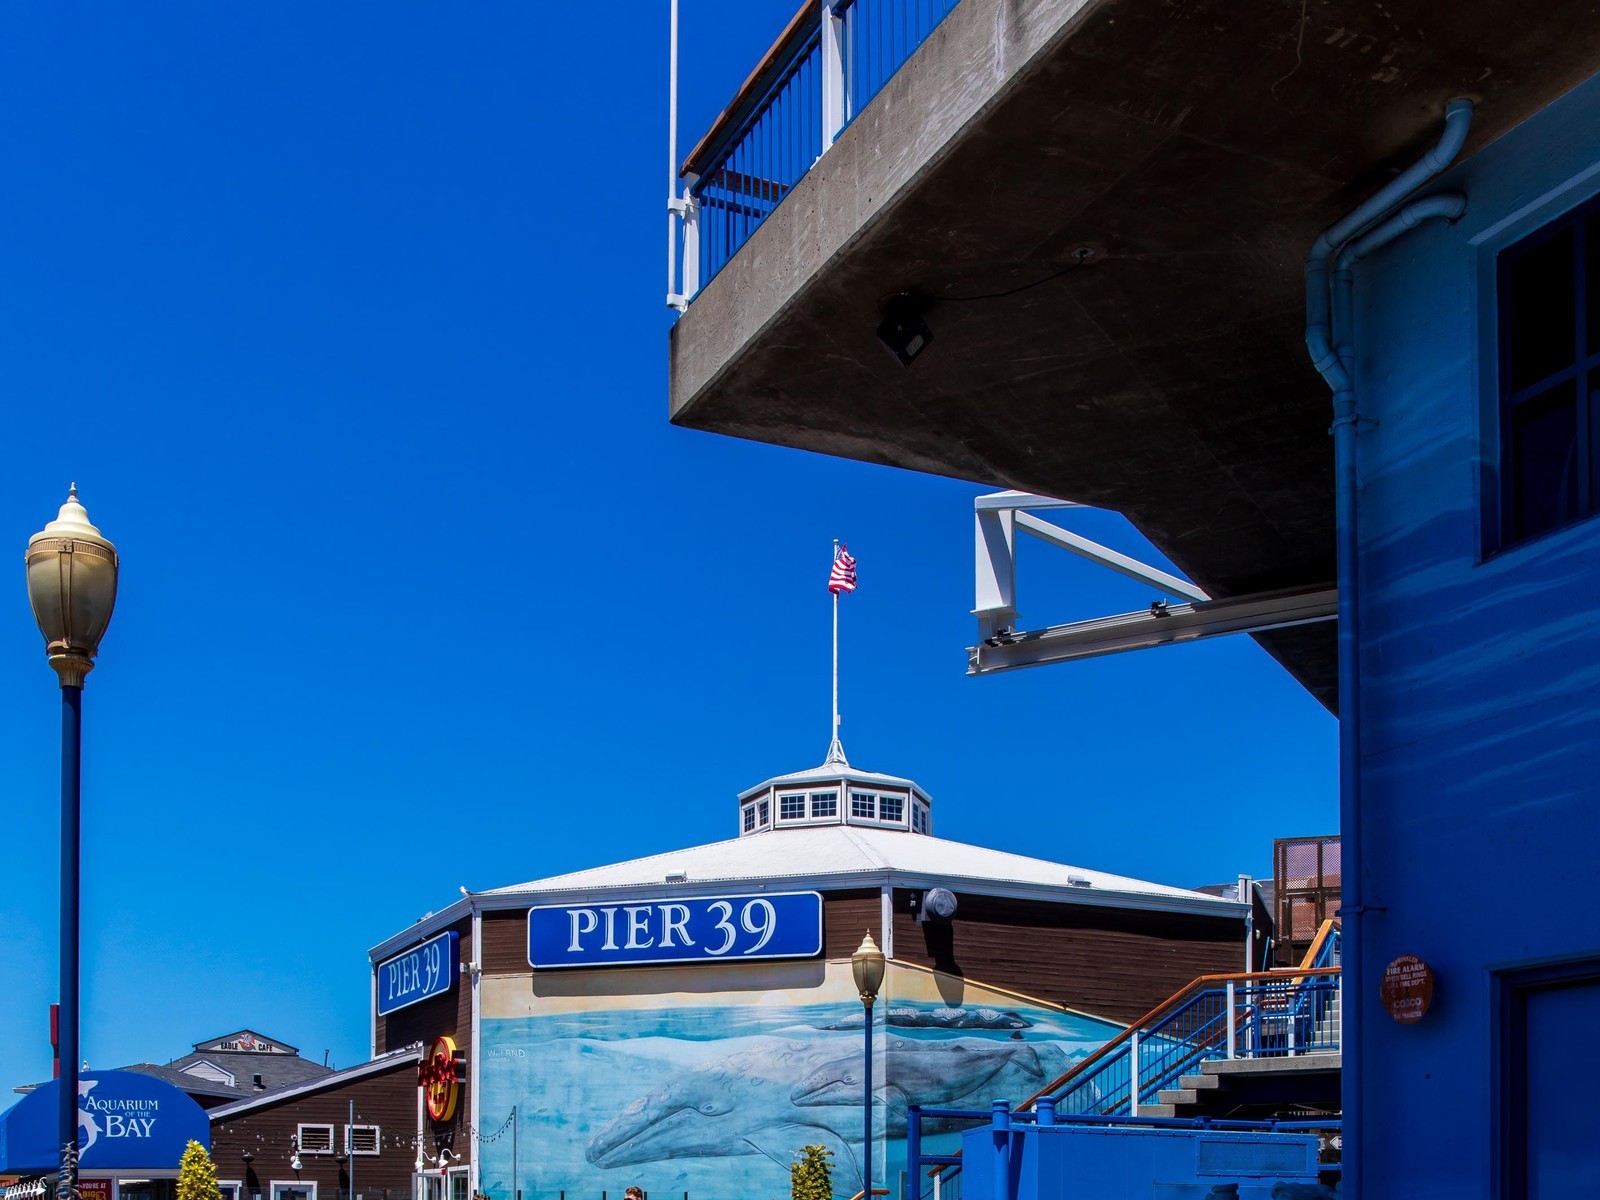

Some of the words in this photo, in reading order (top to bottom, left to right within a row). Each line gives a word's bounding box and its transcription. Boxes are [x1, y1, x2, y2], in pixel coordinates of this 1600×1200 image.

[566, 903, 696, 952] PIER
[704, 898, 777, 956] 39
[388, 953, 421, 1001] PIER
[421, 943, 440, 994] 39
[1387, 967, 1400, 975] FIRE
[1402, 964, 1424, 973] ALARM
[220, 1042, 238, 1050] EAGLE
[258, 1043, 273, 1052] CAFE
[84, 1096, 159, 1114] AQUARIUM
[104, 1115, 157, 1138] BAY
[82, 1190, 96, 1198] BIG
